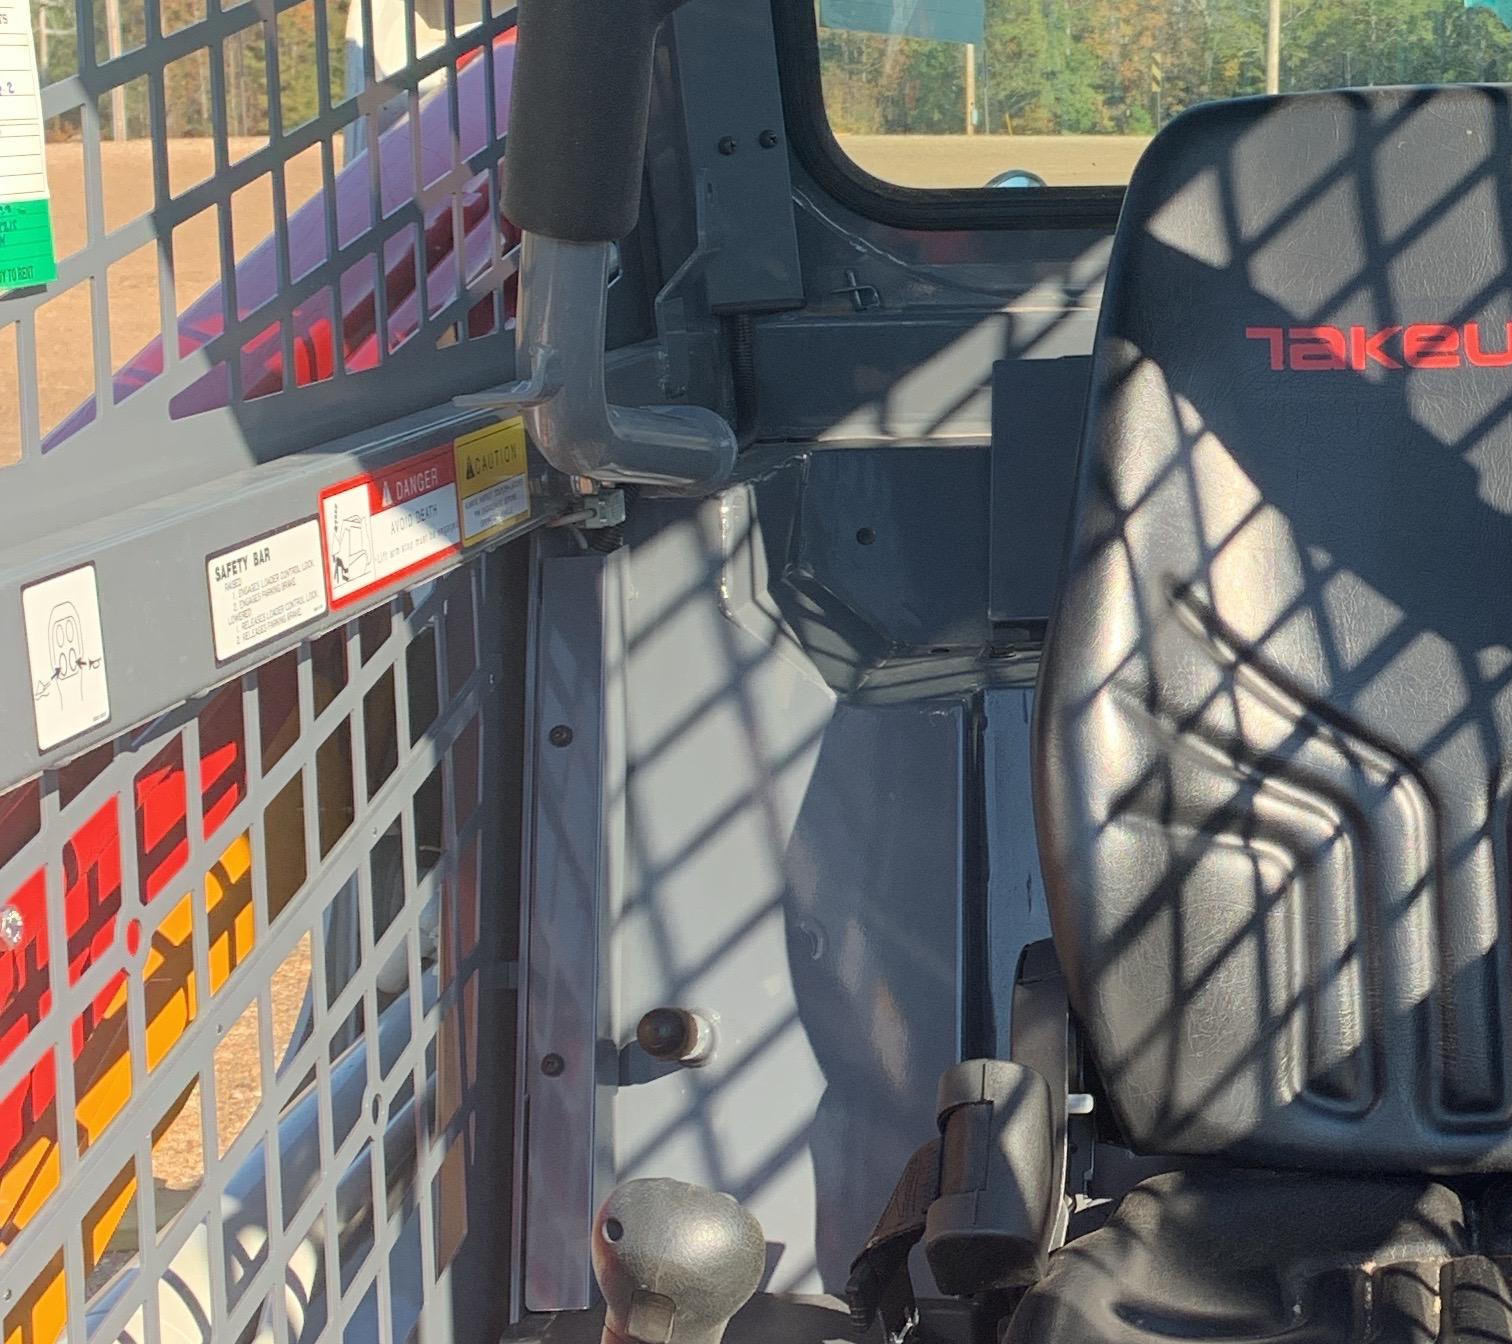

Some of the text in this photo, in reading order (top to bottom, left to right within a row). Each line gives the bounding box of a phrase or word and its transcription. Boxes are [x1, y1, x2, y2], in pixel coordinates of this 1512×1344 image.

[8, 269, 17, 283] TO
[17, 266, 34, 281] RENT
[474, 444, 518, 476] CAUTION
[395, 467, 439, 501] DANGER
[390, 513, 414, 536] AVOID
[214, 546, 271, 583] SAFETY BAR
